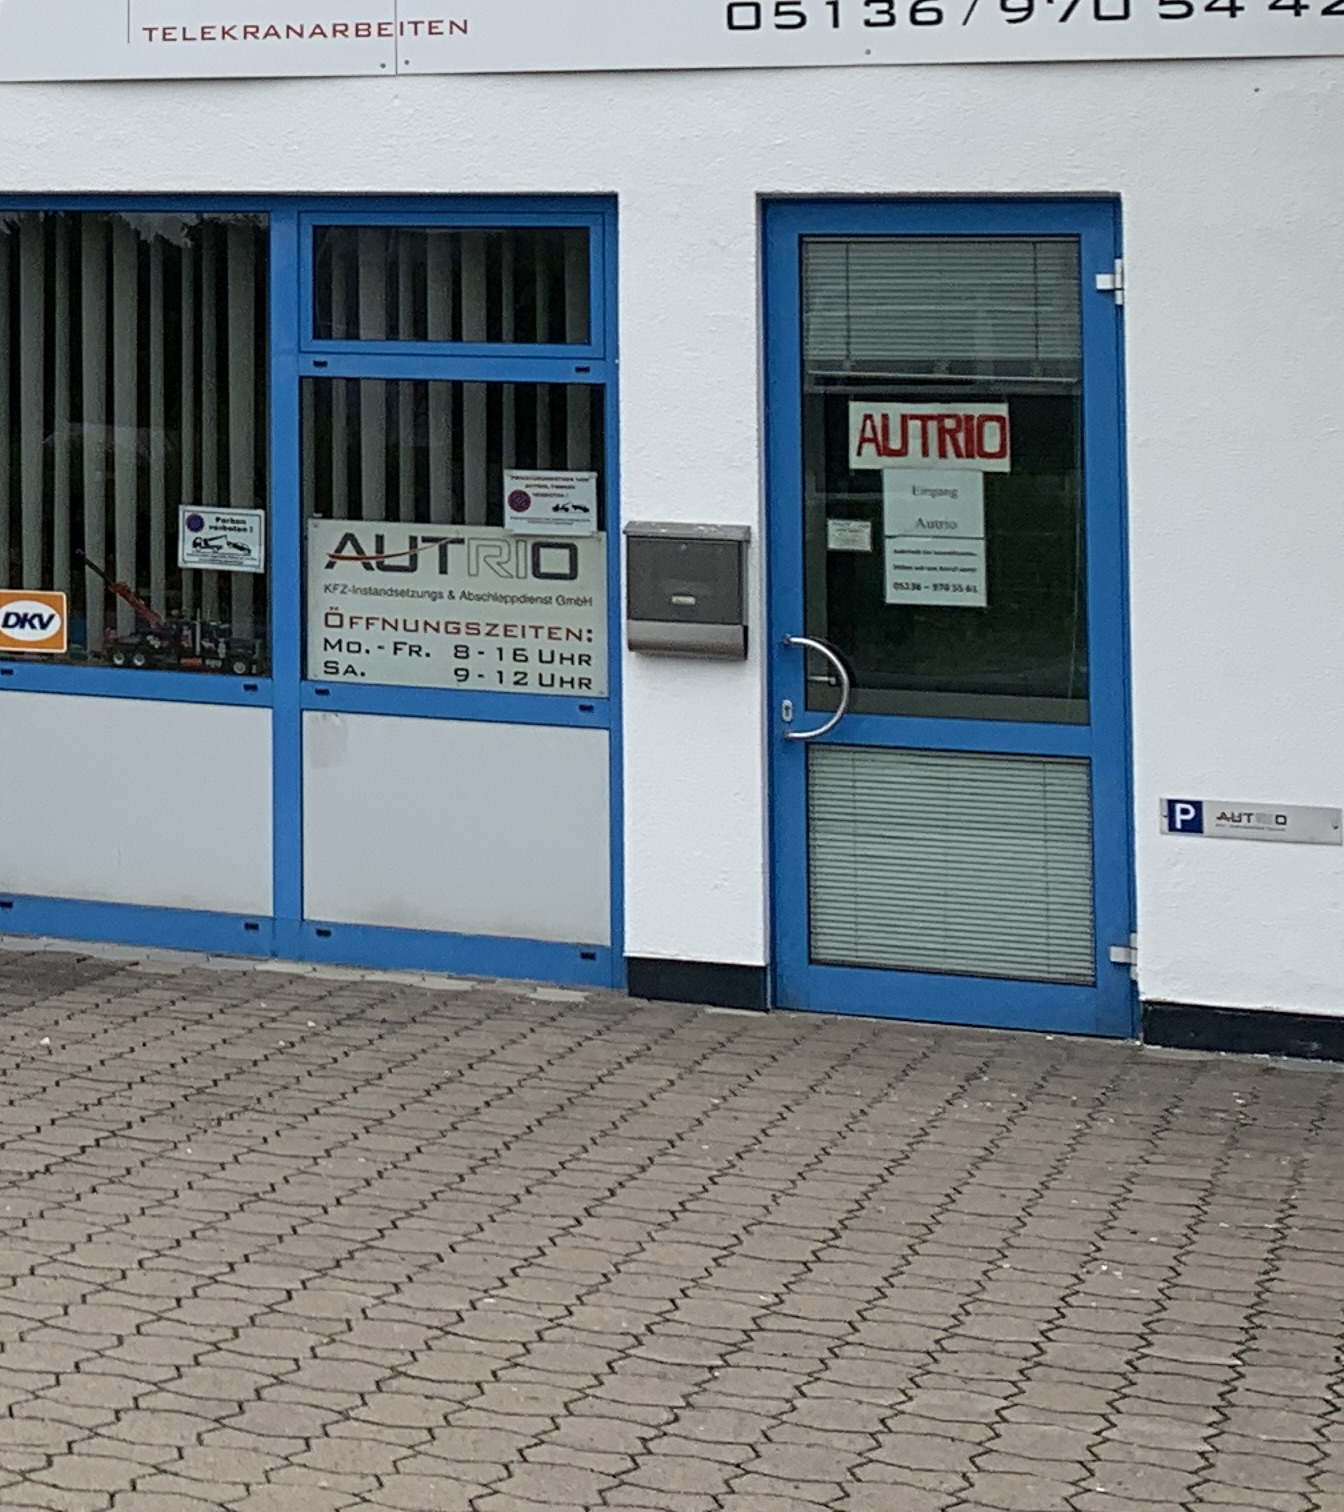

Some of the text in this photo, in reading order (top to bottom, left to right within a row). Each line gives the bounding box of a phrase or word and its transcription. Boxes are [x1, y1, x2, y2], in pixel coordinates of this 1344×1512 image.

[142, 19, 470, 42] TELEKRANARBEITEN
[856, 413, 1008, 459] AUTRIO
[324, 532, 578, 580] AUTRIO
[448, 590, 455, 600] &
[555, 595, 593, 607] GmbH
[1, 611, 56, 630] DKV
[324, 607, 593, 643] ÖFFNUNGSZEITEN:
[538, 649, 592, 666] UHR
[324, 660, 366, 677] SA.
[538, 671, 592, 690] UHR
